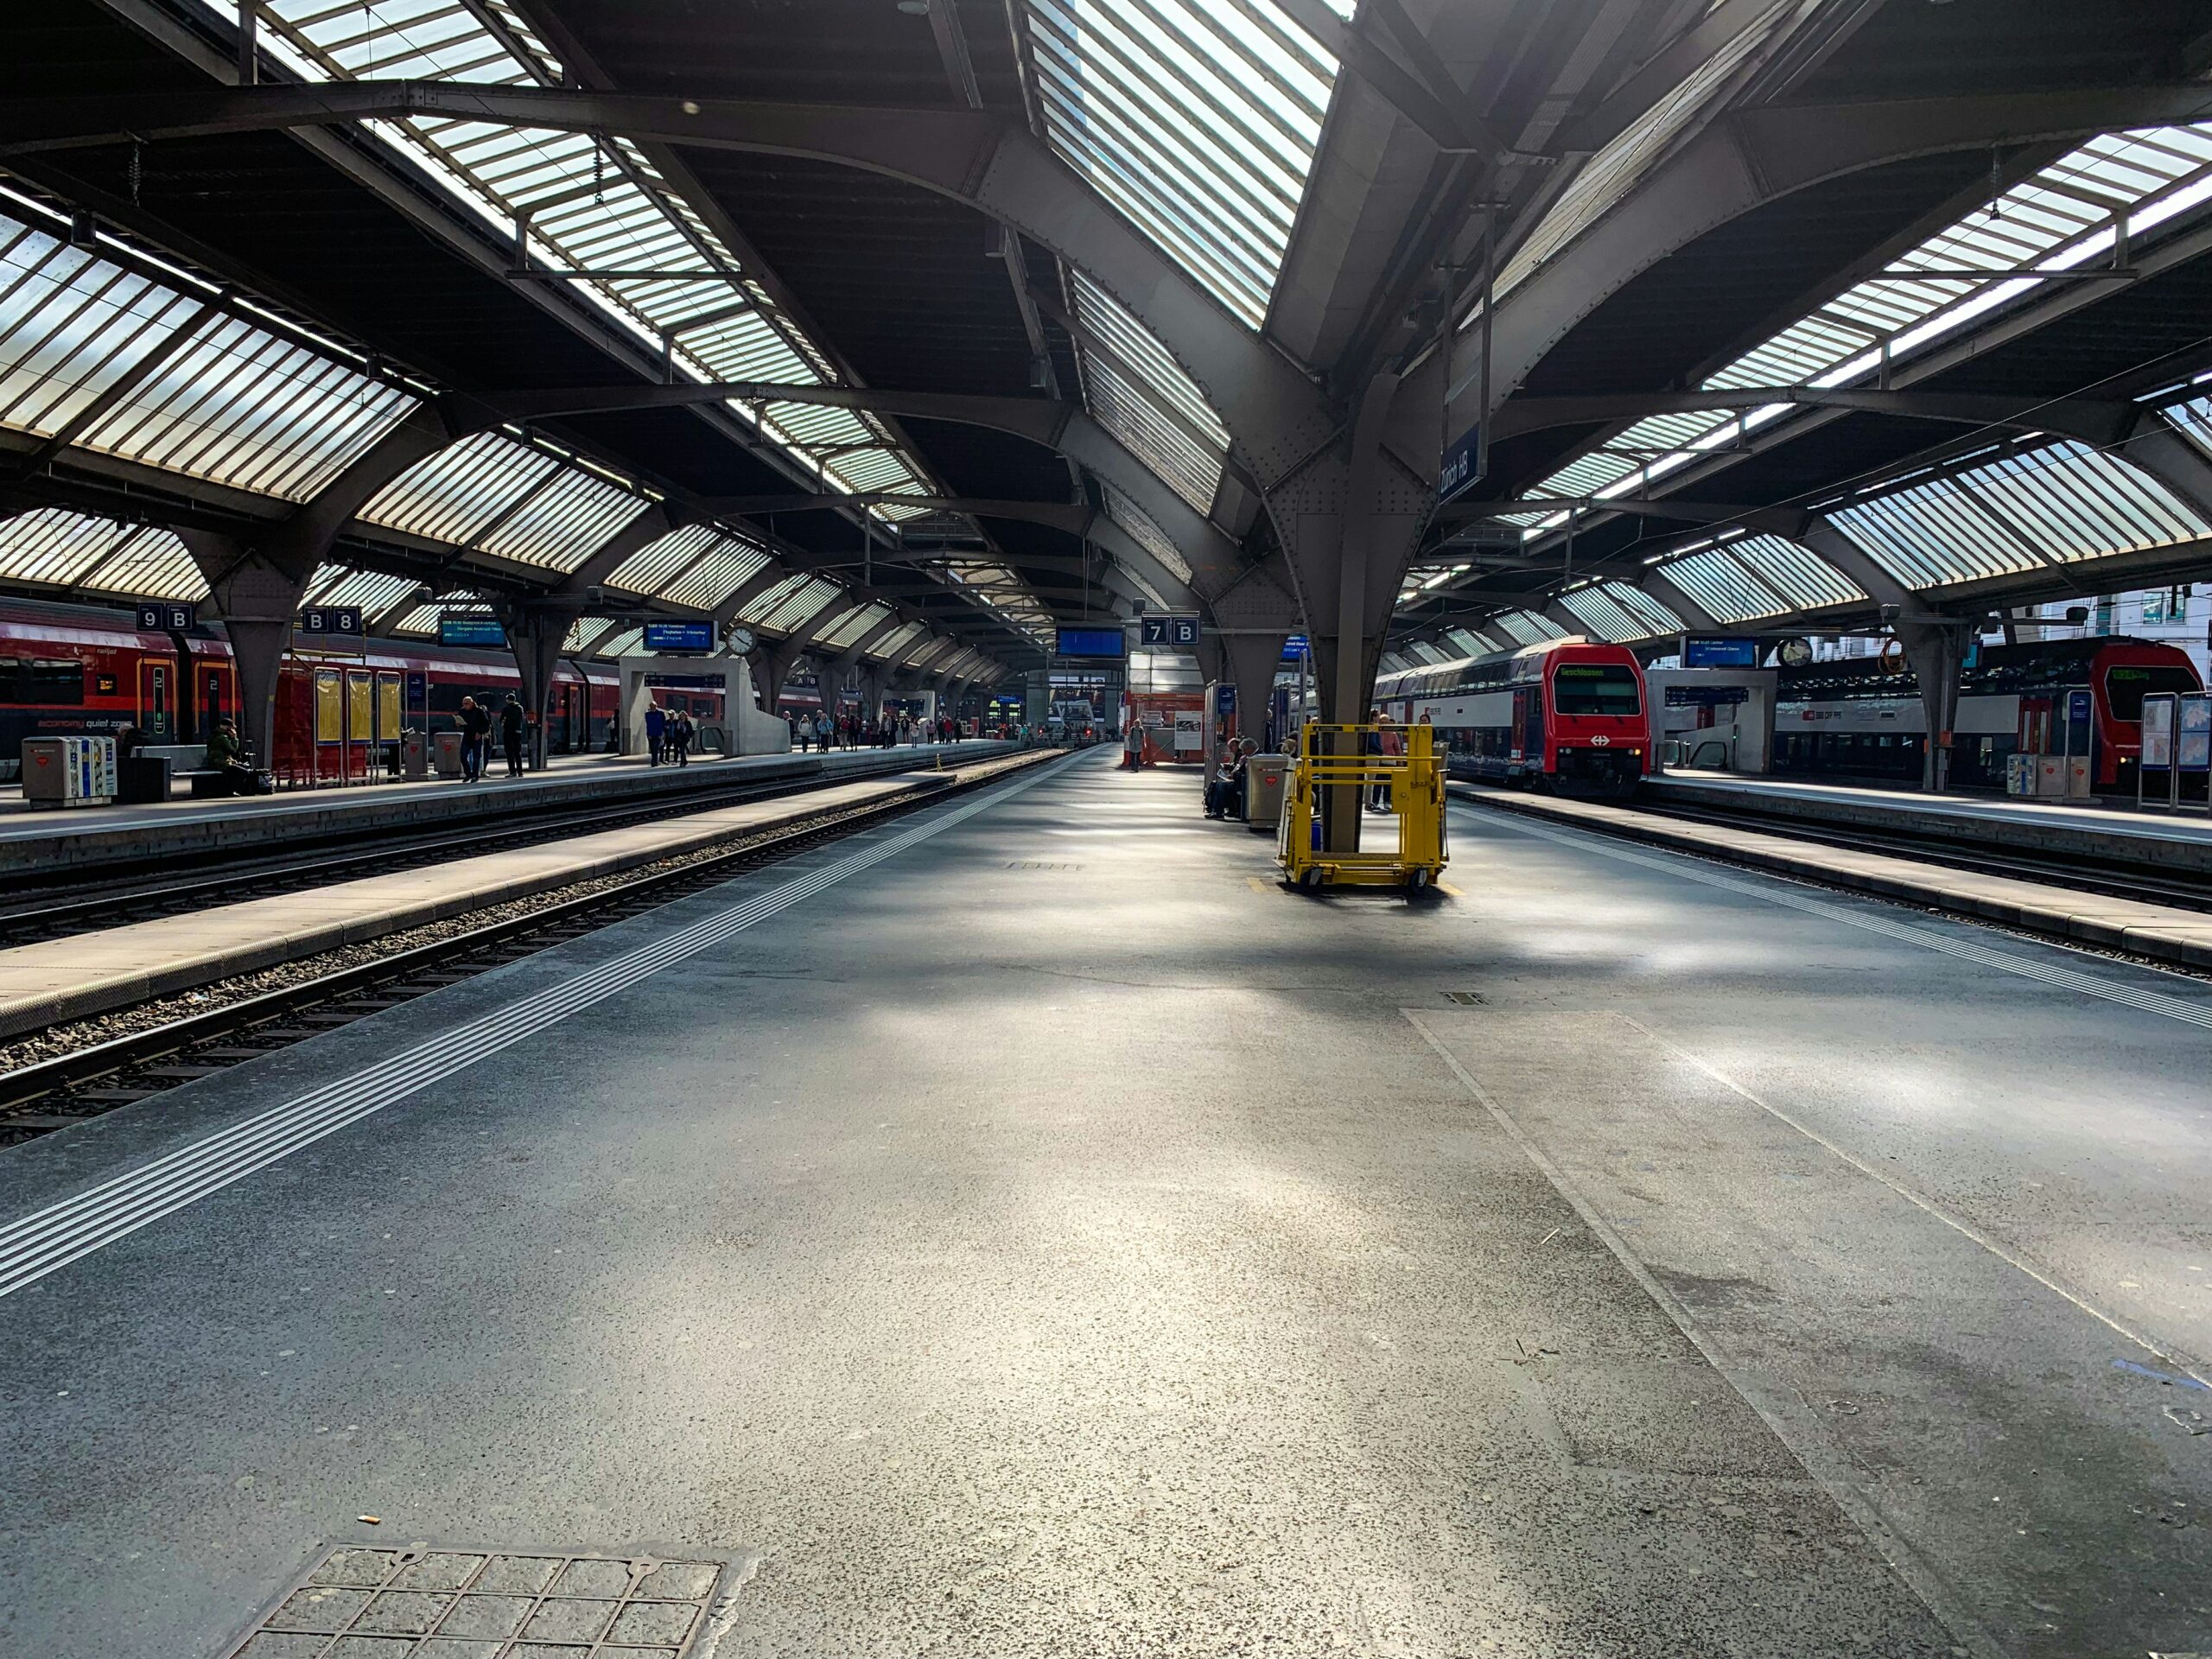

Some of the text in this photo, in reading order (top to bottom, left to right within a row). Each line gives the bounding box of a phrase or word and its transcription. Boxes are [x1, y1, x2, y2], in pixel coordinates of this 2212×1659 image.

[1440, 449, 1468, 493] Zürich HB
[144, 612, 156, 626] 9
[174, 613, 186, 626] B
[311, 614, 322, 629] B
[340, 614, 352, 629] 8
[1150, 626, 1161, 640] 7
[1179, 626, 1192, 640] B
[1560, 668, 1605, 677] Geschlossen
[156, 677, 162, 688] 2
[210, 679, 218, 690] 2
[38, 719, 85, 729] economy
[86, 719, 109, 729] quiet
